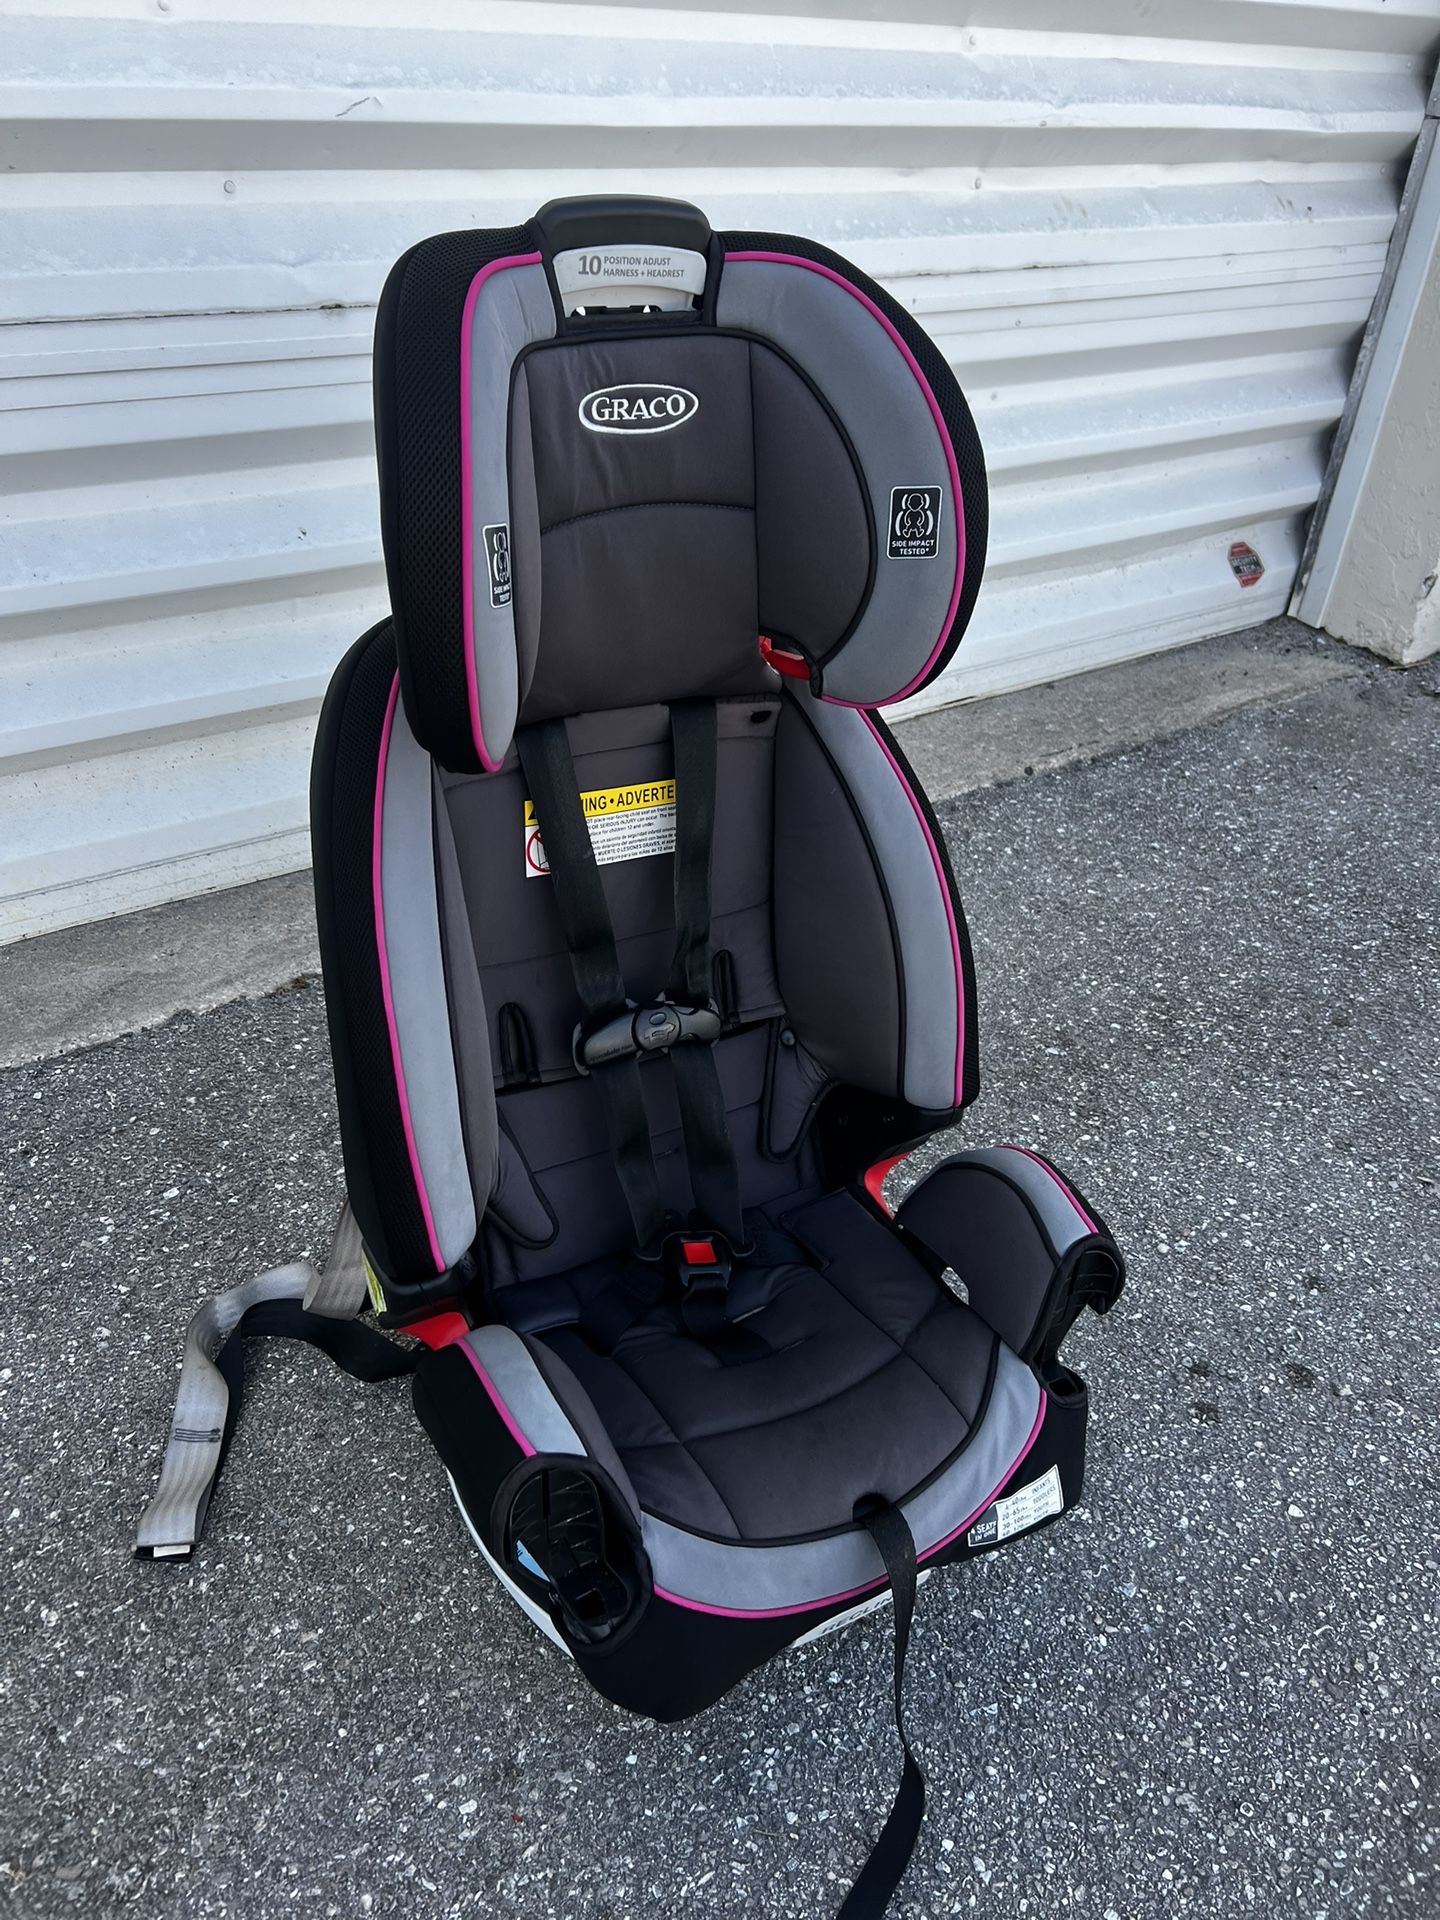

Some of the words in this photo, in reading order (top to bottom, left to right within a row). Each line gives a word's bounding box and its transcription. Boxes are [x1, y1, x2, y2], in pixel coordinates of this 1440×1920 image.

[578, 255, 602, 276] 10
[604, 256, 641, 266] POSITION
[643, 257, 671, 266] ADJUST
[604, 268, 639, 277] HARNESS
[647, 269, 684, 278] HEADREST
[591, 394, 686, 421] GRACO
[616, 785, 674, 806] ADVERTE
[822, 1597, 892, 1634] RECLIN
